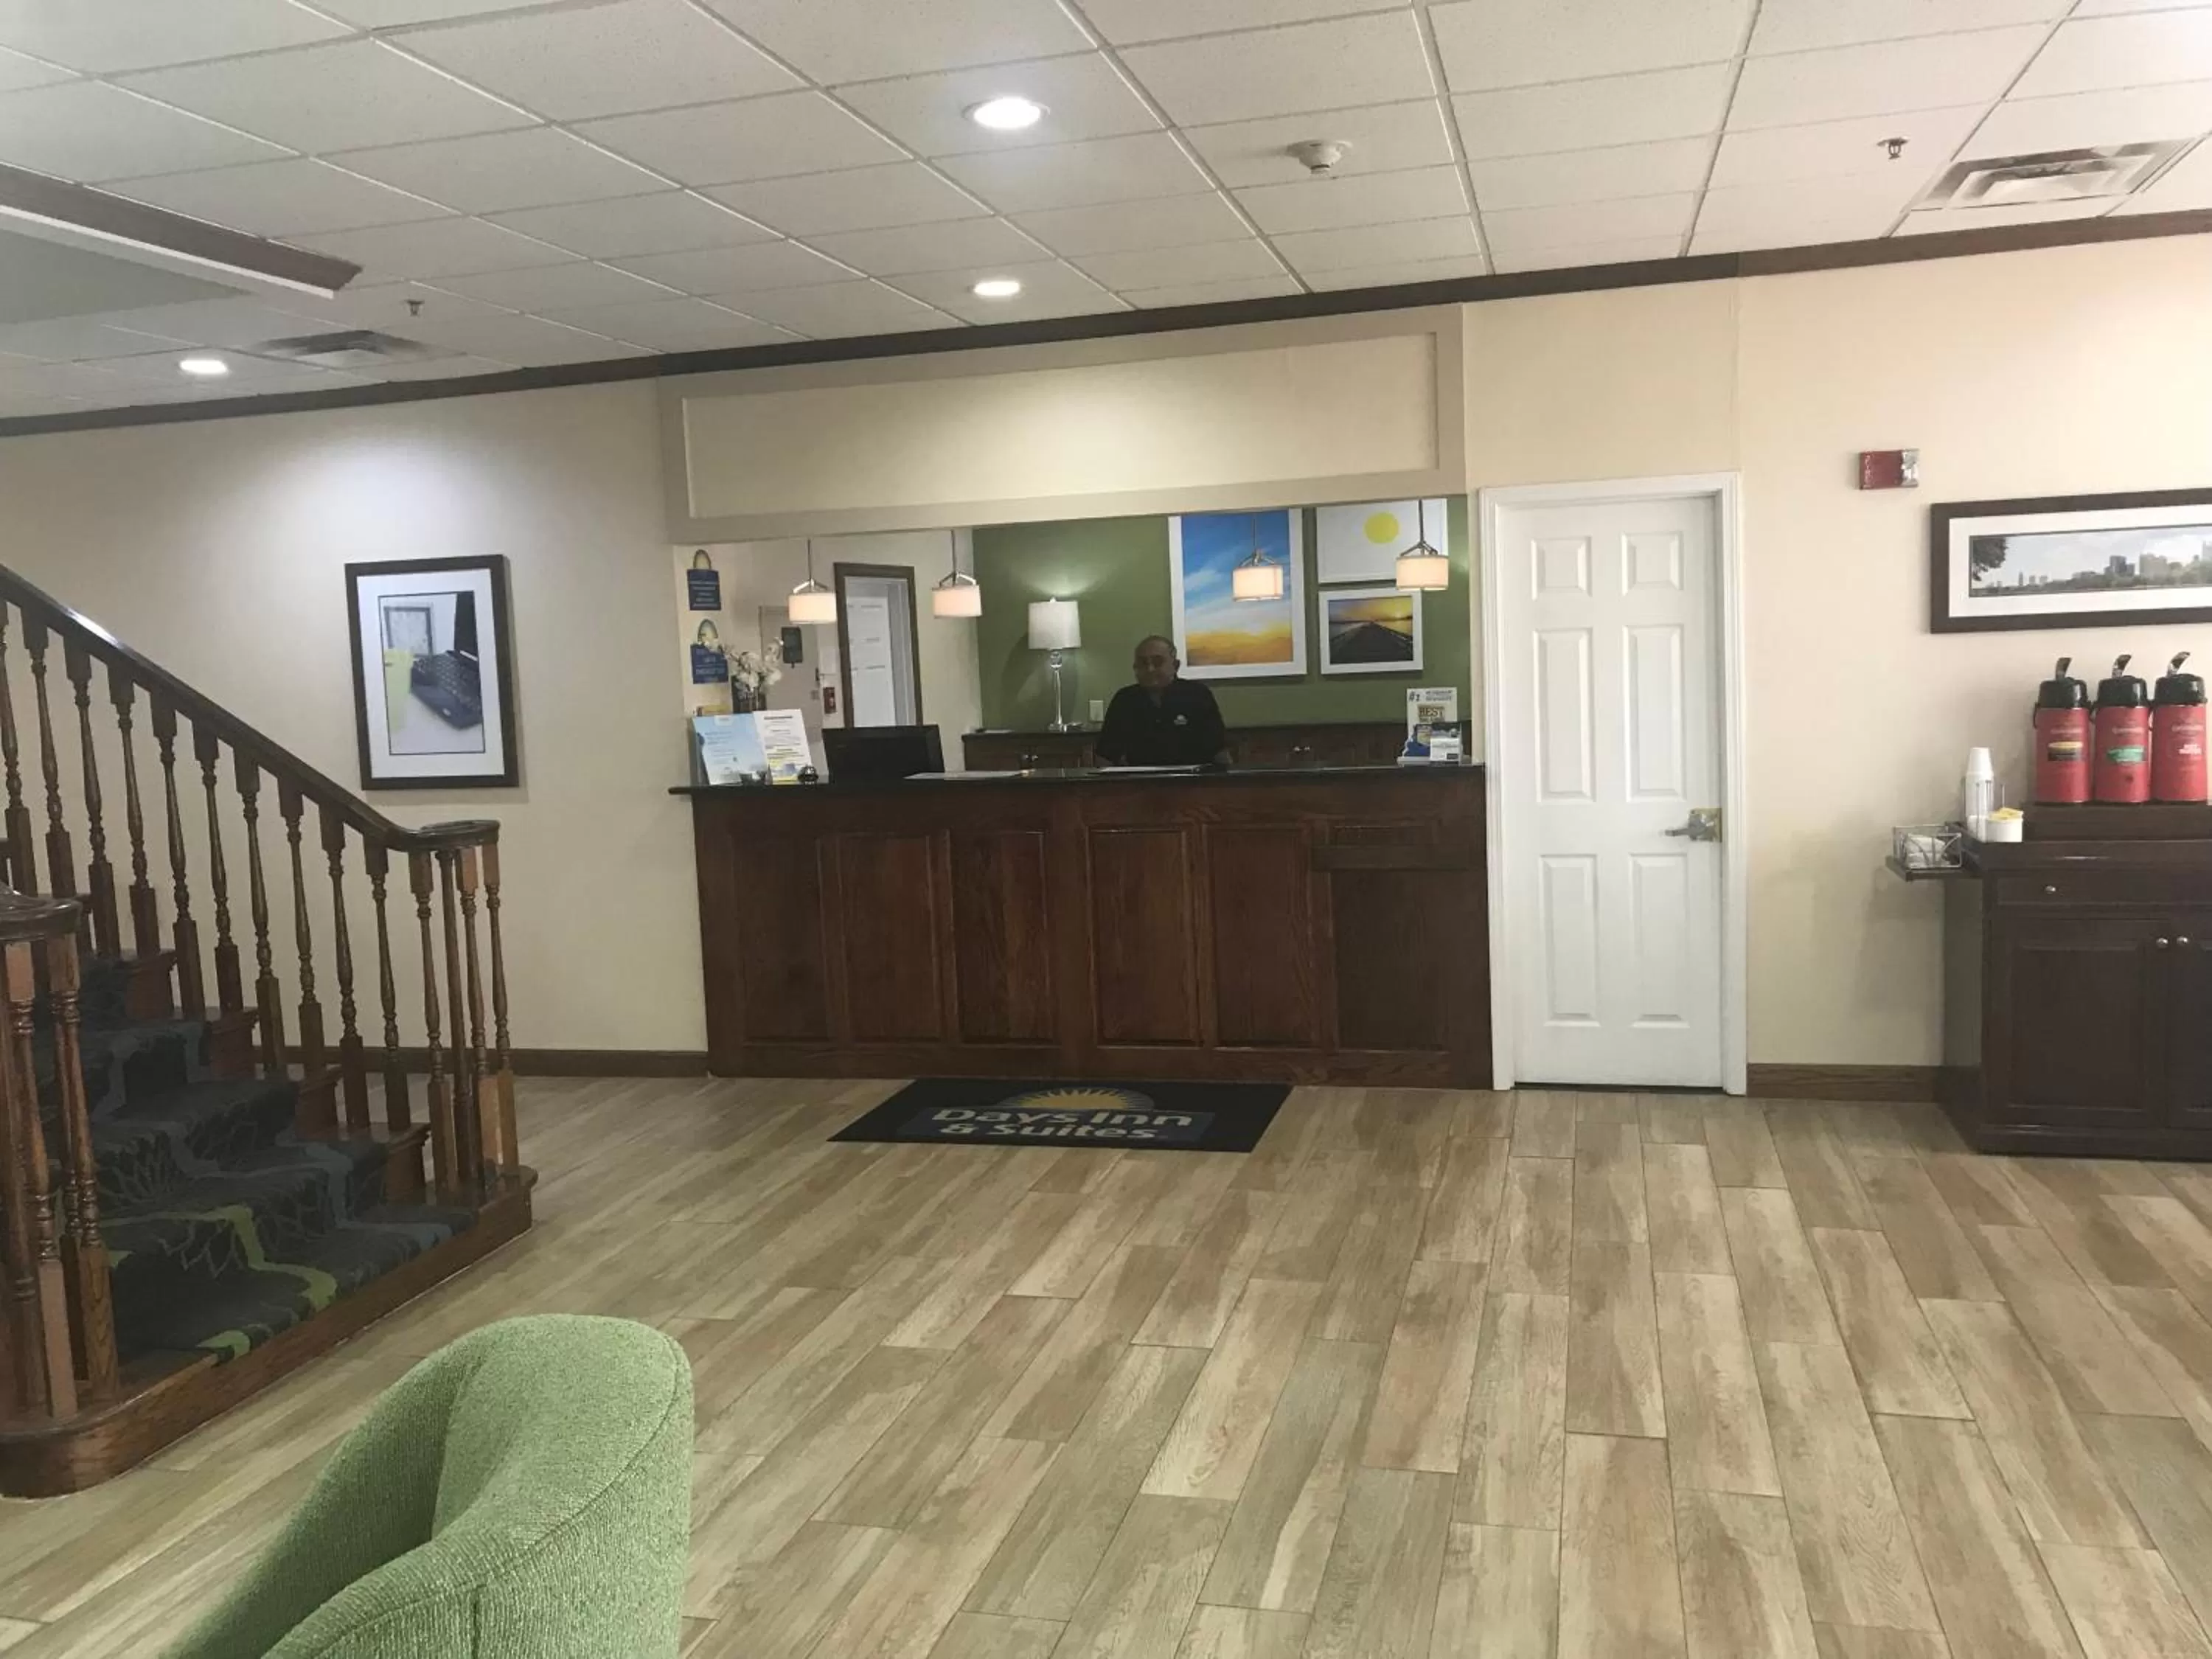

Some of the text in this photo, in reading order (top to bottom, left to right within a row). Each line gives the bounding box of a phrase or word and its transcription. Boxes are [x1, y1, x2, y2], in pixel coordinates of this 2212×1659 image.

[932, 1108, 1193, 1127] Days Inn
[939, 1124, 1158, 1138] & Suites
